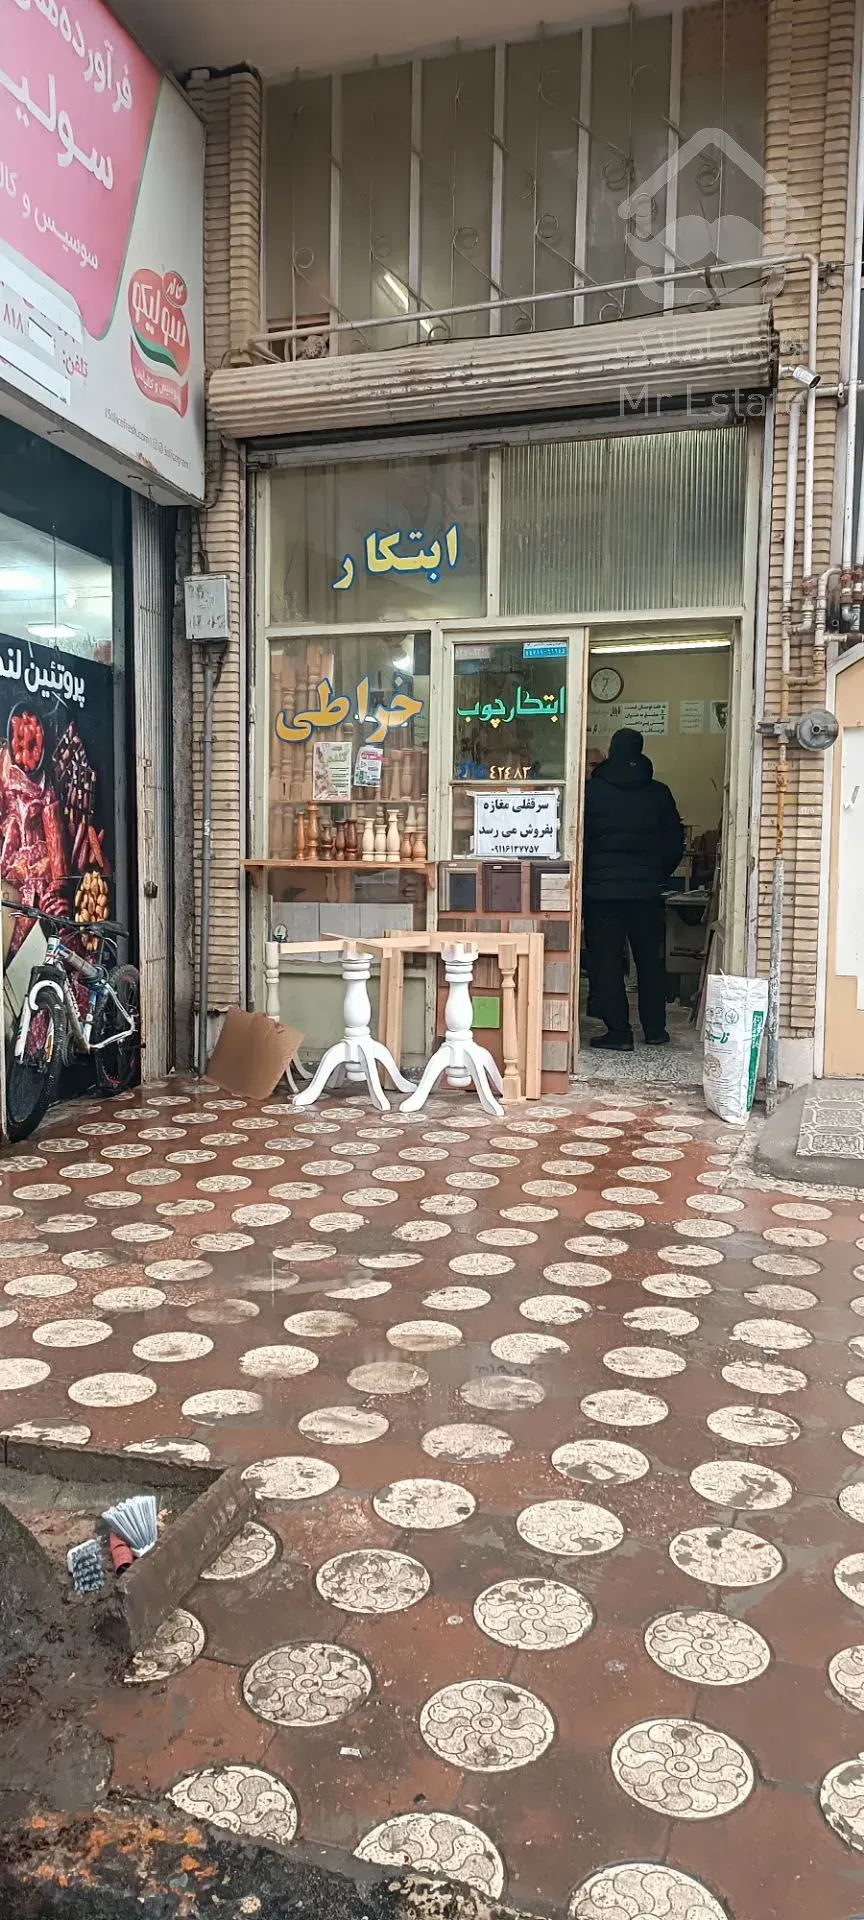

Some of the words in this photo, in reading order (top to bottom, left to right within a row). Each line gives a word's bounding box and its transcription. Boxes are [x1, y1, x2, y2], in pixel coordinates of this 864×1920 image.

[22, 193, 30, 219] و
[34, 207, 98, 270] سوسیس
[132, 281, 186, 348] سولیکو
[333, 523, 460, 590] ابتکار
[24, 660, 86, 708] پروتئین
[274, 672, 424, 745] خراطی
[483, 798, 510, 813] مغازه
[512, 797, 549, 813] سرقفلی
[479, 825, 499, 838] رسد
[501, 827, 518, 838] می
[519, 824, 553, 838] بفروش
